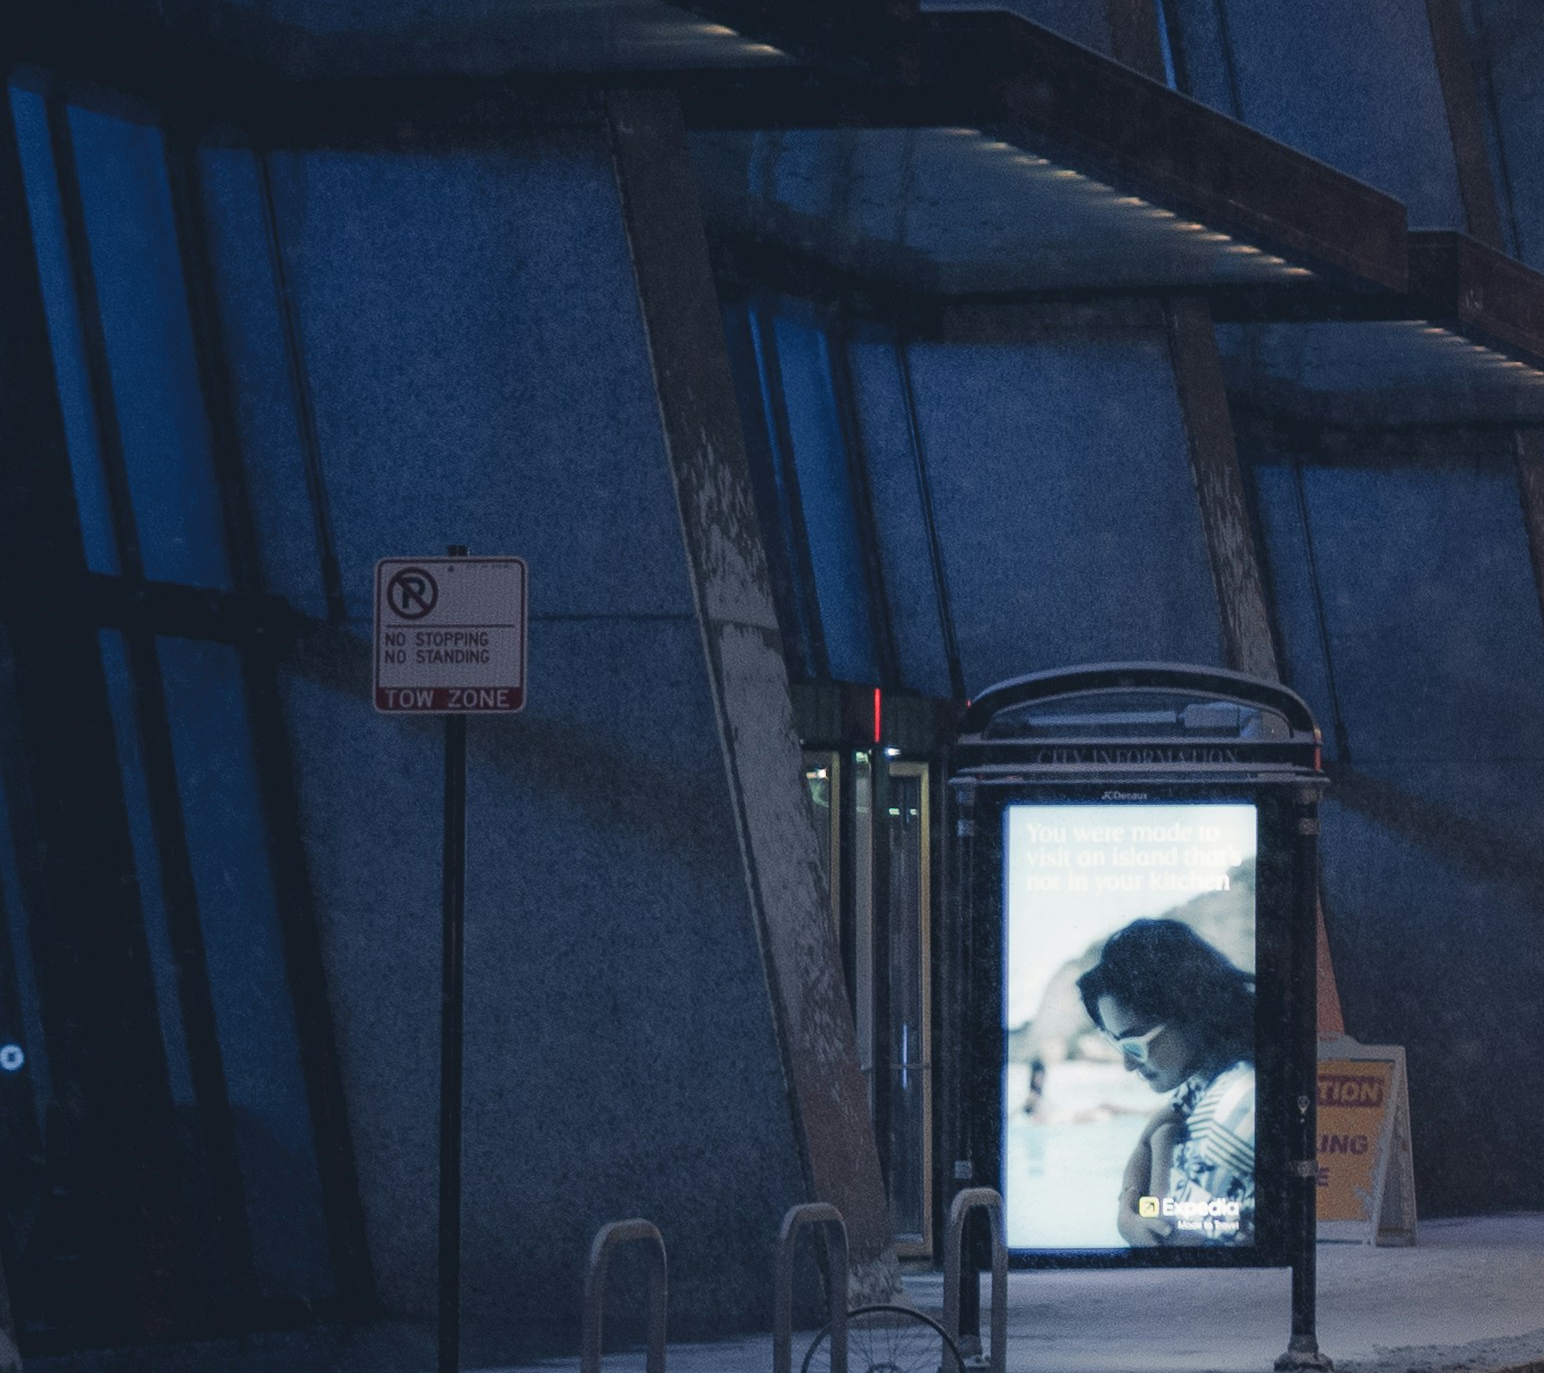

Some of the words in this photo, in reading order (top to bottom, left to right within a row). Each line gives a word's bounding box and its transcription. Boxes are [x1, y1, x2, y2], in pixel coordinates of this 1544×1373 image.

[385, 632, 406, 647] NO
[416, 632, 489, 647] STOPPING
[385, 649, 407, 664] NO
[416, 649, 490, 664] STANDING
[384, 689, 434, 708] TOW
[447, 689, 511, 708] ZONE
[1092, 748, 1240, 764] INFORMATION
[1027, 824, 1066, 842] You
[1074, 827, 1125, 842] were
[1132, 822, 1192, 842] made
[1199, 825, 1221, 842] to
[1027, 846, 1071, 867] visit
[1078, 850, 1105, 867] an
[1113, 846, 1178, 867] island
[1027, 873, 1060, 891] not
[1068, 871, 1088, 891] in
[1094, 875, 1144, 897] your
[1151, 871, 1230, 891] kitchen
[1163, 1197, 1240, 1218] Expedia
